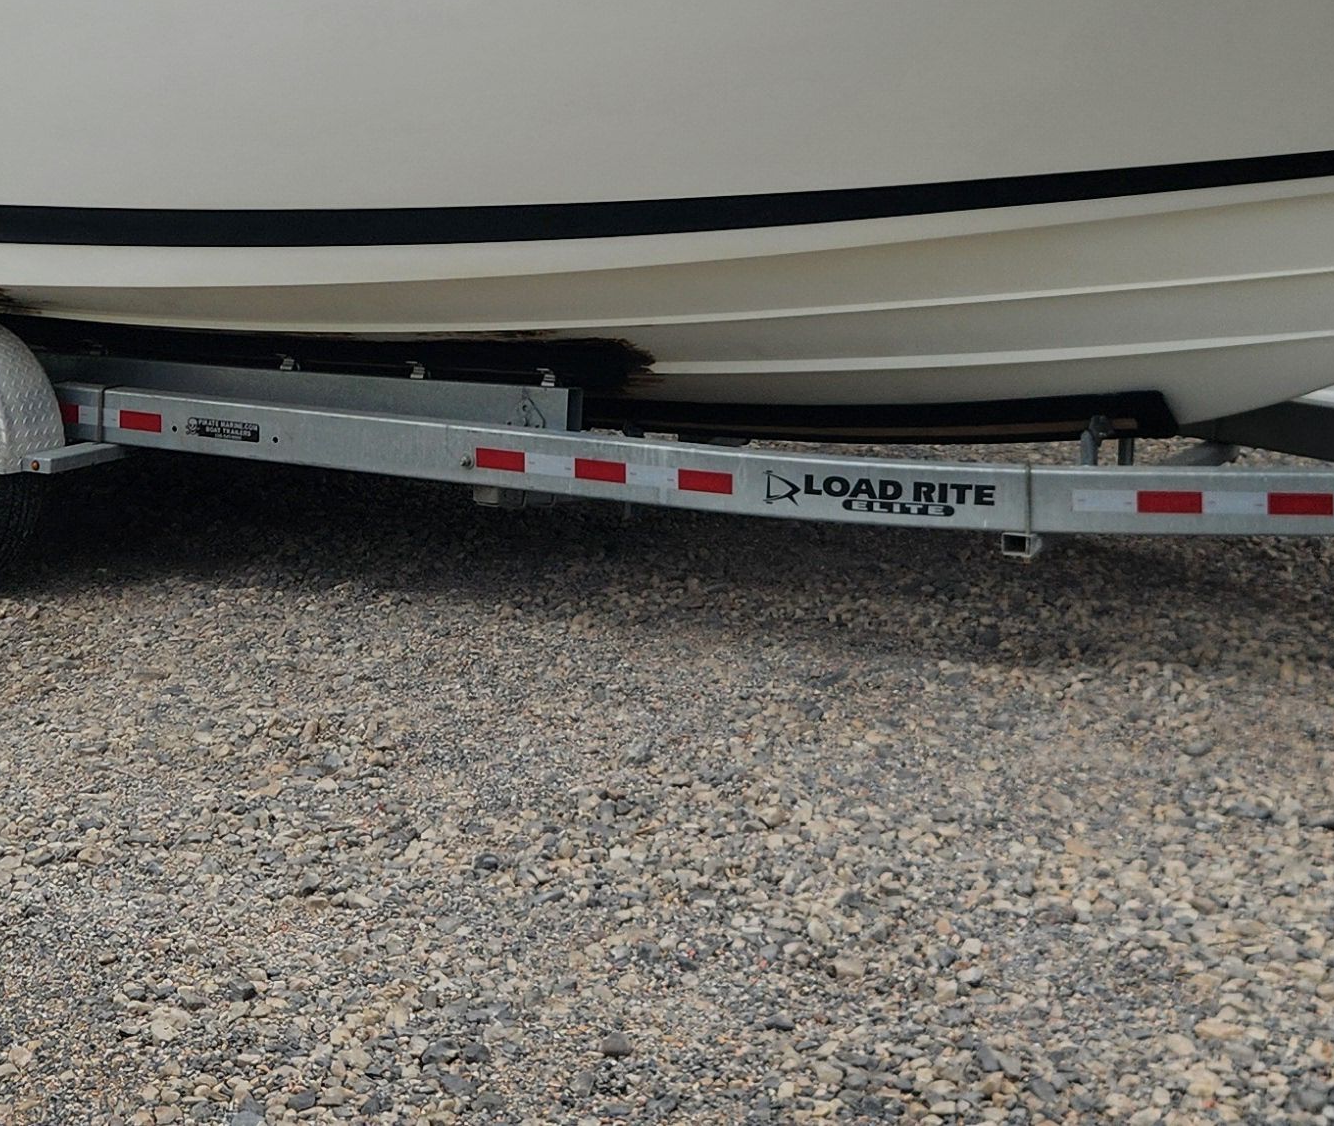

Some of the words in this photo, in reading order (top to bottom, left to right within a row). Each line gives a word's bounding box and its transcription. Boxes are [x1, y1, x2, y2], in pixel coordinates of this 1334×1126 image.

[804, 474, 903, 501] LOAD
[913, 481, 996, 506] RITE
[851, 500, 947, 516] ELITE
